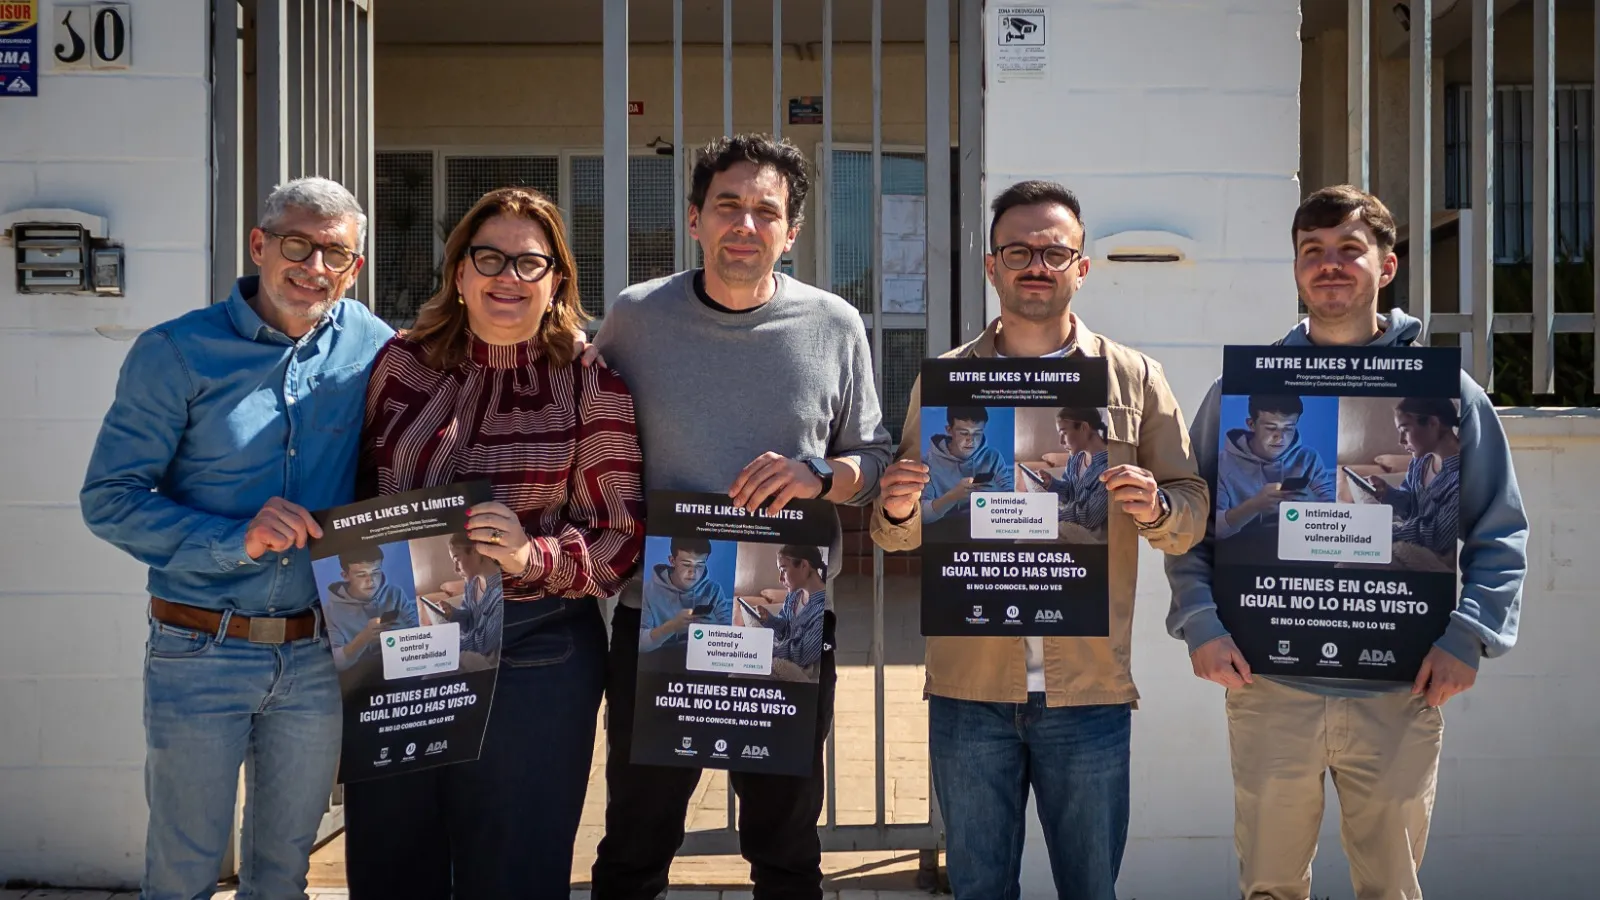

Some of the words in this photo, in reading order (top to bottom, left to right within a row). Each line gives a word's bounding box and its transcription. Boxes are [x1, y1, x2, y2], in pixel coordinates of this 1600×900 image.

[1256, 357, 1301, 369] ENTRE
[1305, 358, 1346, 369] LIKES
[1350, 358, 1360, 370] Y
[1364, 356, 1423, 370] LÍMITES
[950, 372, 986, 381] ENTRE
[989, 372, 1021, 382] LIKES
[1024, 372, 1031, 381] Y
[1035, 371, 1080, 382] LÍMITES
[333, 512, 372, 530] ENTRE
[375, 504, 409, 520] LIKES
[411, 502, 419, 512] Y
[421, 495, 465, 510] LÍMITES
[675, 503, 711, 514] ENTRE
[714, 505, 745, 517] LIKES
[1305, 509, 1352, 519] Intimidad,
[1305, 534, 1371, 543] vulnerabilidad
[953, 552, 969, 562] LO
[973, 552, 1015, 562] TIENES
[1018, 552, 1035, 562] EN
[1038, 552, 1075, 563] CASA.
[942, 566, 978, 577] IGUAL
[981, 566, 1000, 577] NO
[1004, 567, 1019, 577] LO
[1022, 567, 1047, 577] HAS
[1050, 567, 1087, 577] VISTO
[1256, 576, 1275, 589] LO
[1279, 577, 1334, 592] TIENES
[1339, 580, 1359, 593] EN
[1364, 581, 1412, 595] CASA.
[1240, 594, 1286, 608] IGUAL
[1290, 596, 1314, 609] NO
[1318, 597, 1338, 610] LO
[1343, 599, 1376, 612] HAS
[1380, 600, 1428, 614] VISTO
[1035, 610, 1063, 620] ADA
[1307, 619, 1350, 628] CONOCES,
[399, 632, 432, 642] Intimidad,
[708, 630, 743, 639] Intimidad,
[400, 643, 424, 652] control
[401, 650, 446, 661] vulnerabilidad
[707, 650, 757, 659] vulnerabilidad
[1358, 649, 1396, 662] ADA
[370, 694, 384, 706] LO
[386, 689, 422, 704] TIENES
[423, 687, 438, 699] EN
[439, 682, 469, 696] CASA.
[668, 682, 684, 693] LO
[686, 683, 728, 696] TIENES
[730, 686, 747, 697] EN
[750, 688, 785, 700] CASA.
[360, 709, 390, 722] IGUAL
[392, 706, 408, 718] NO
[410, 703, 423, 715] LO
[424, 700, 446, 713] HAS
[448, 694, 477, 709] VISTO
[656, 696, 691, 708] IGUAL
[694, 698, 712, 709] NO
[715, 700, 731, 710] LO
[733, 701, 758, 713] HAS
[760, 702, 796, 715] VISTO
[401, 720, 427, 730] CONOCES,
[705, 717, 738, 725] CONOCES,
[425, 740, 448, 752] ADA
[742, 745, 770, 756] ADA
